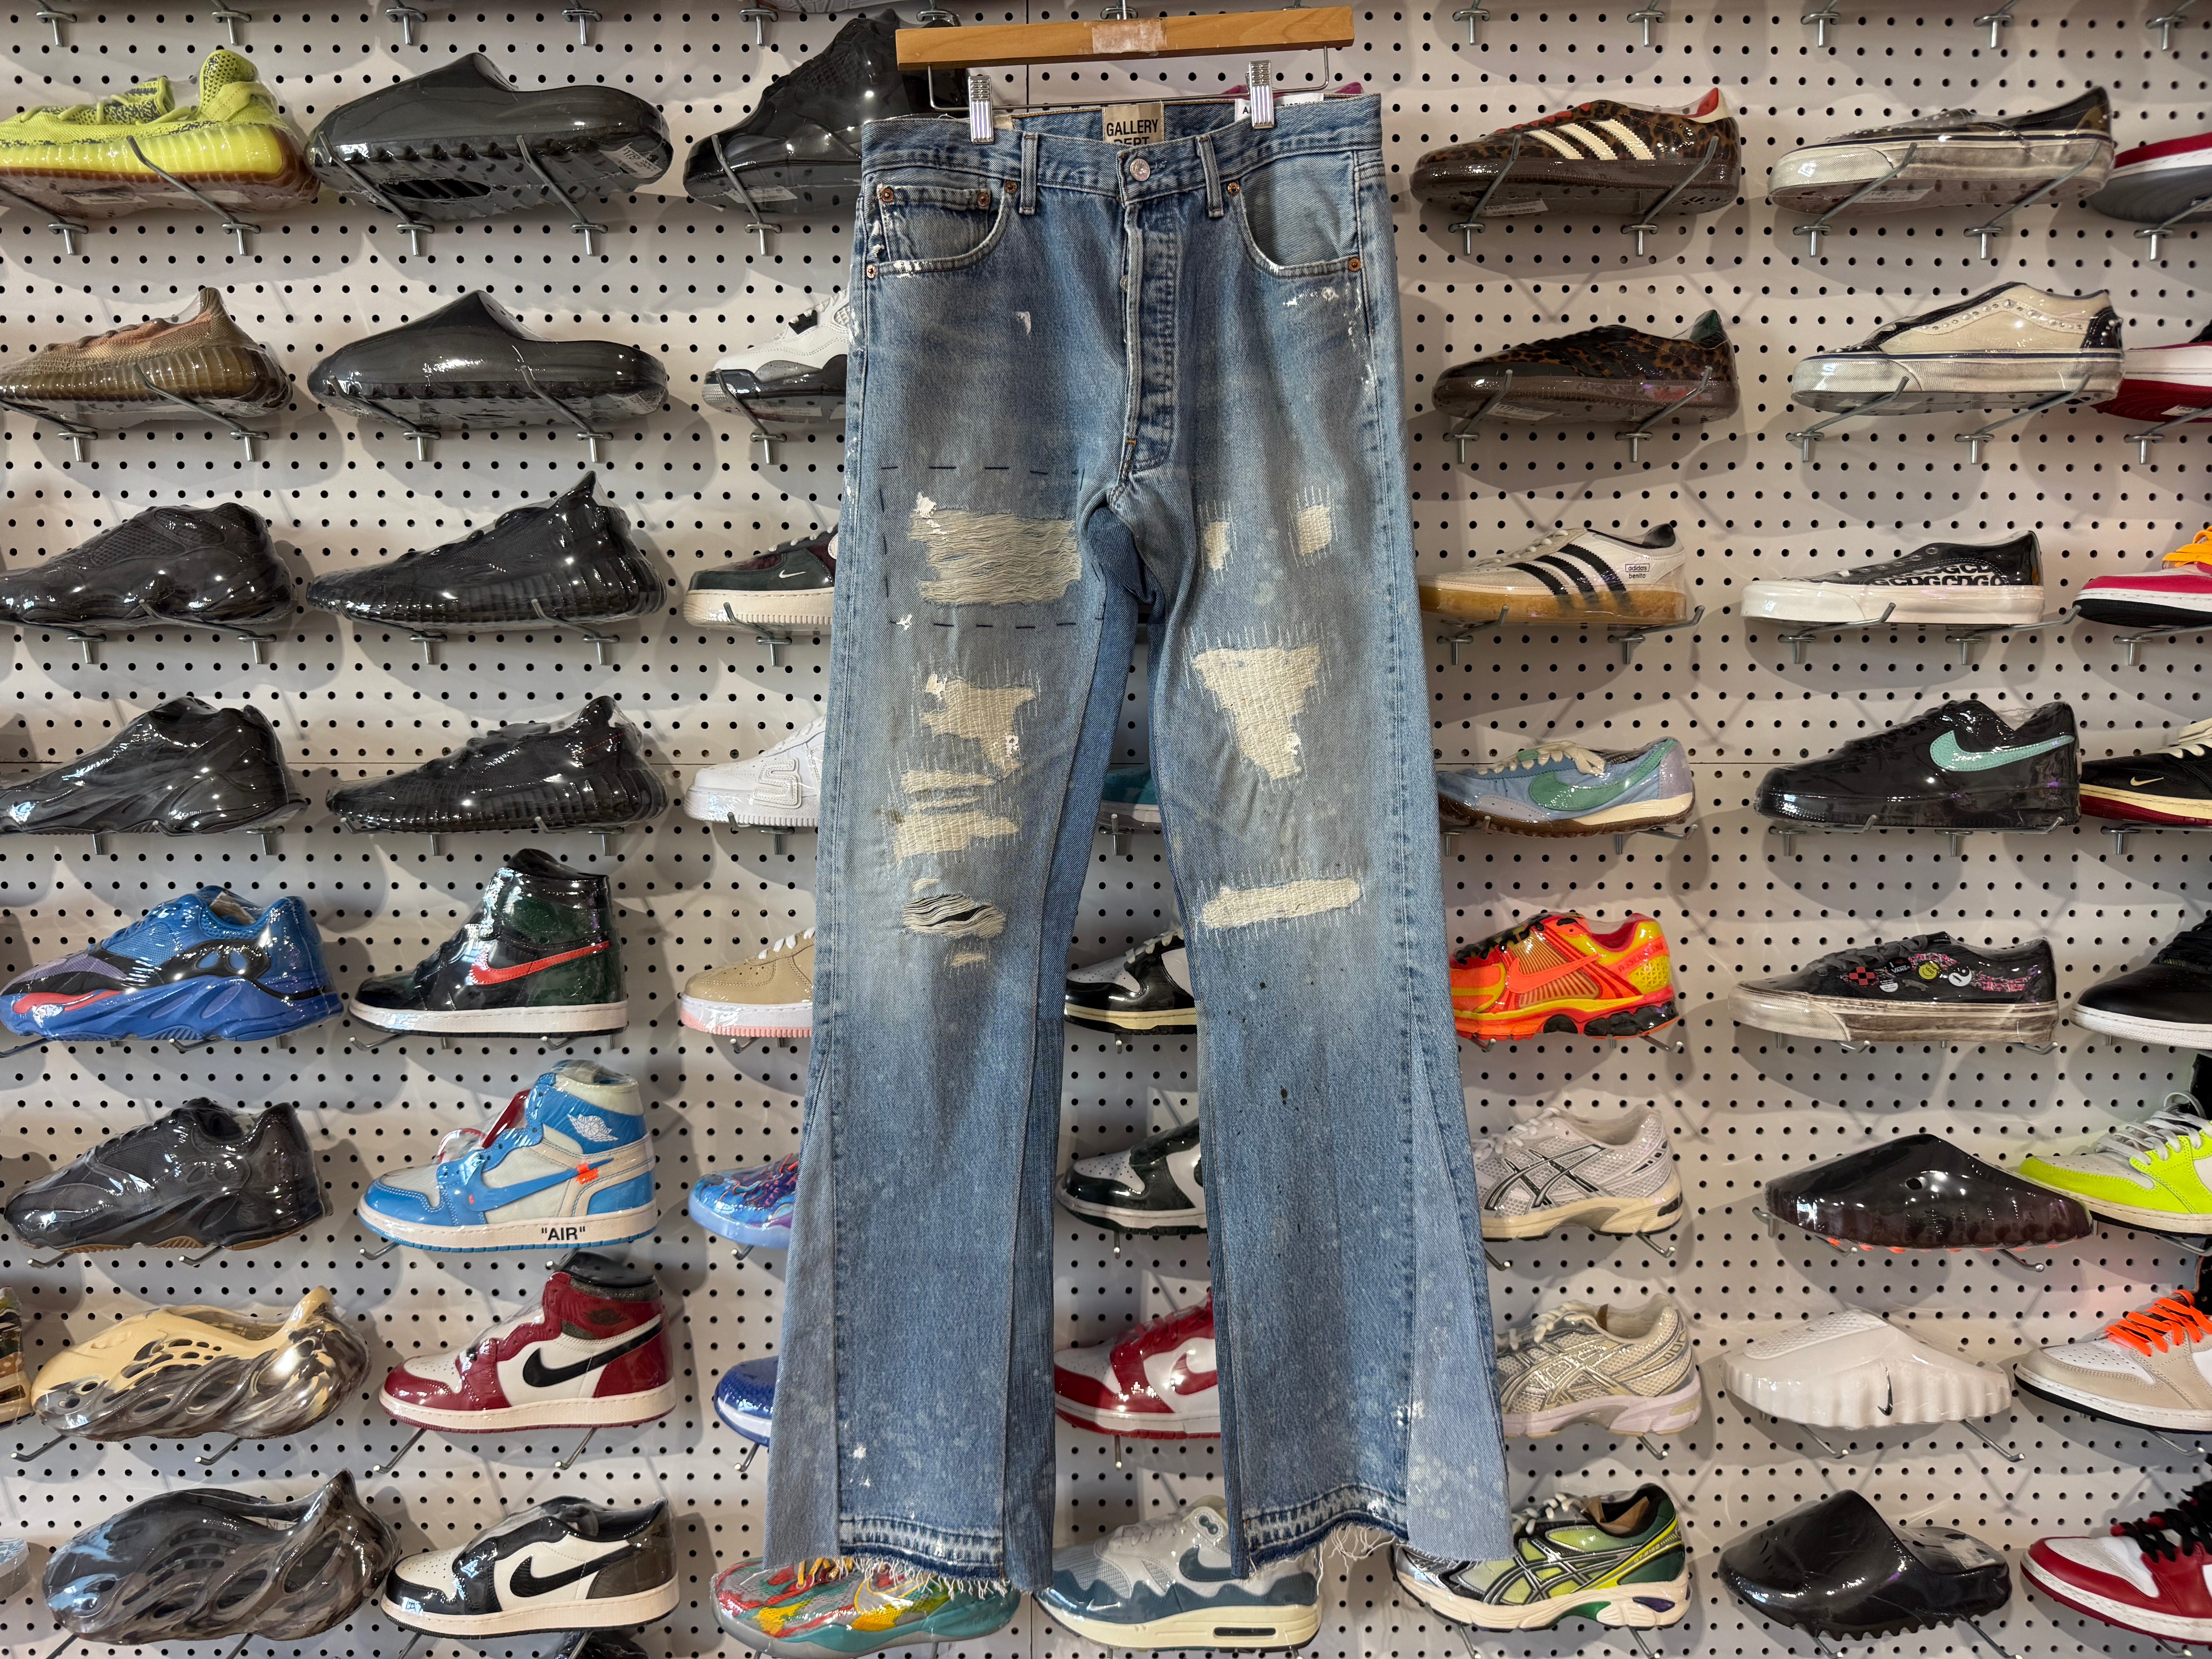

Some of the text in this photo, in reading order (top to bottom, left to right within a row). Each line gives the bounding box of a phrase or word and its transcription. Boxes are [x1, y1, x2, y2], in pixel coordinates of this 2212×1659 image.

[1106, 119, 1158, 137] GALLERY
[591, 1116, 611, 1134] JORDAN
[541, 1226, 586, 1241] "AIR"
